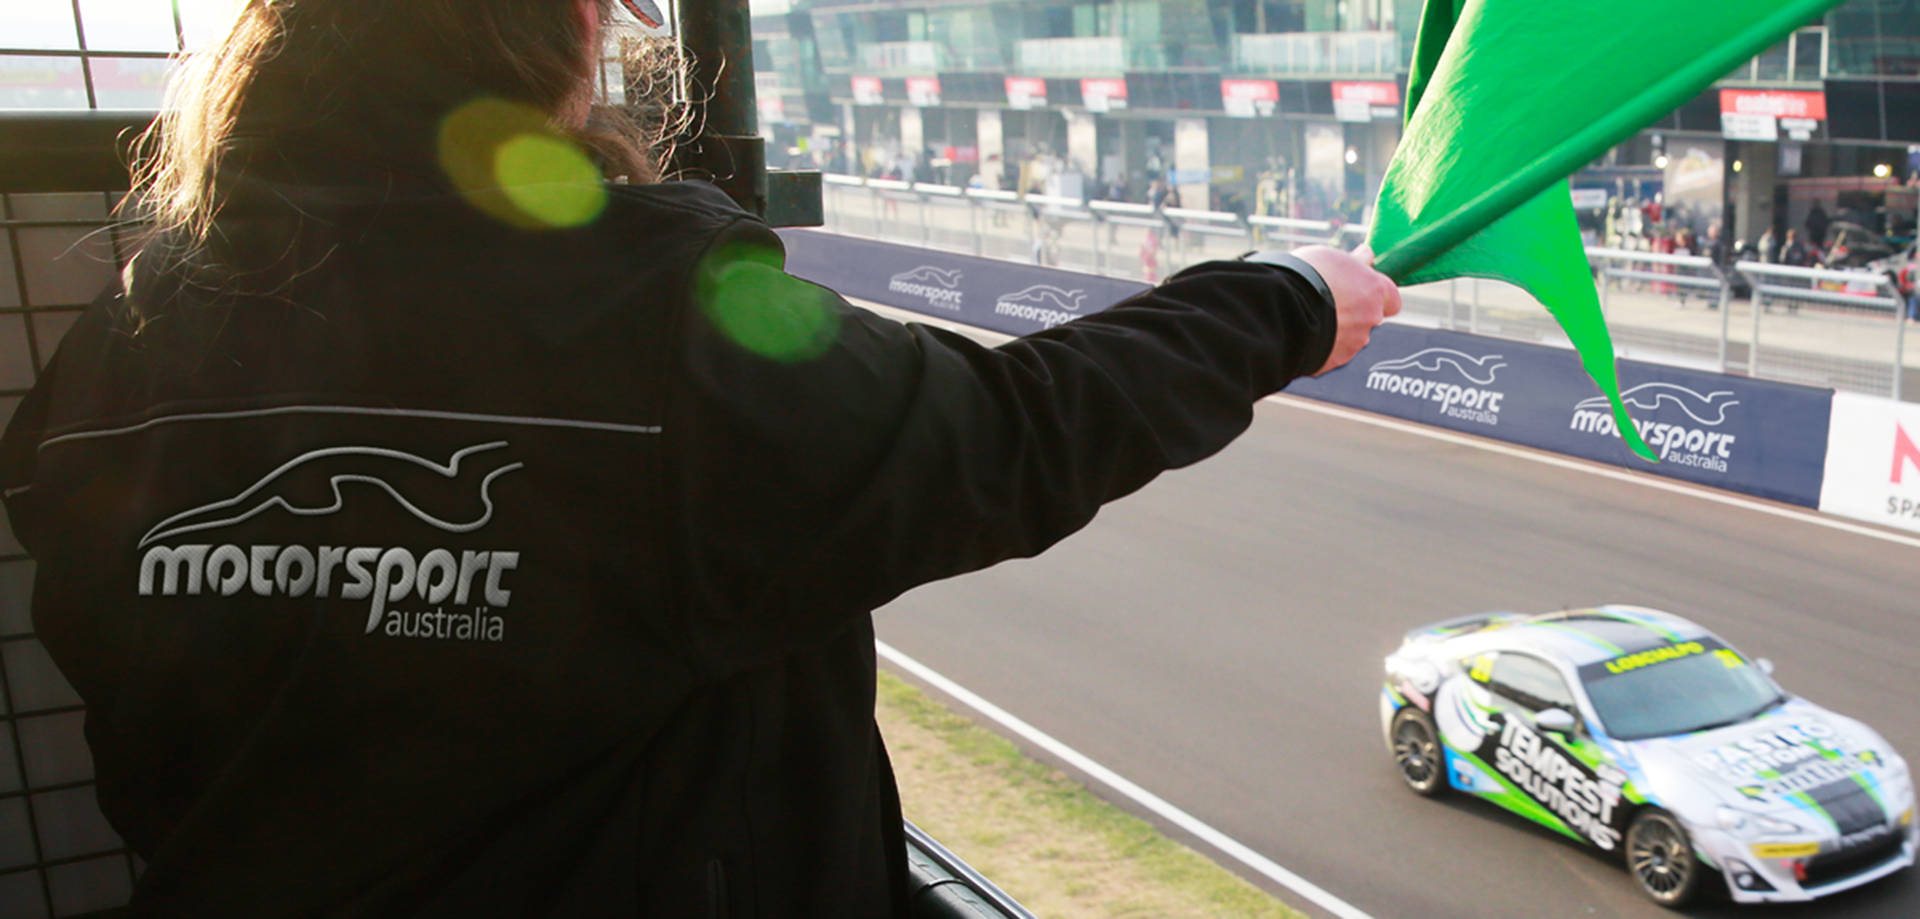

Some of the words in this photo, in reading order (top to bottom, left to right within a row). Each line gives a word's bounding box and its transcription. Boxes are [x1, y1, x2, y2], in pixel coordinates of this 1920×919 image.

[889, 280, 963, 304] motorsport
[1366, 371, 1504, 414] motorsport
[1447, 406, 1498, 425] australia
[1668, 451, 1727, 473] australia
[138, 544, 520, 634] motorsport
[385, 607, 504, 641] australia
[1501, 712, 1620, 824] TEMPEST
[1496, 746, 1621, 850] SOLUTIONS
